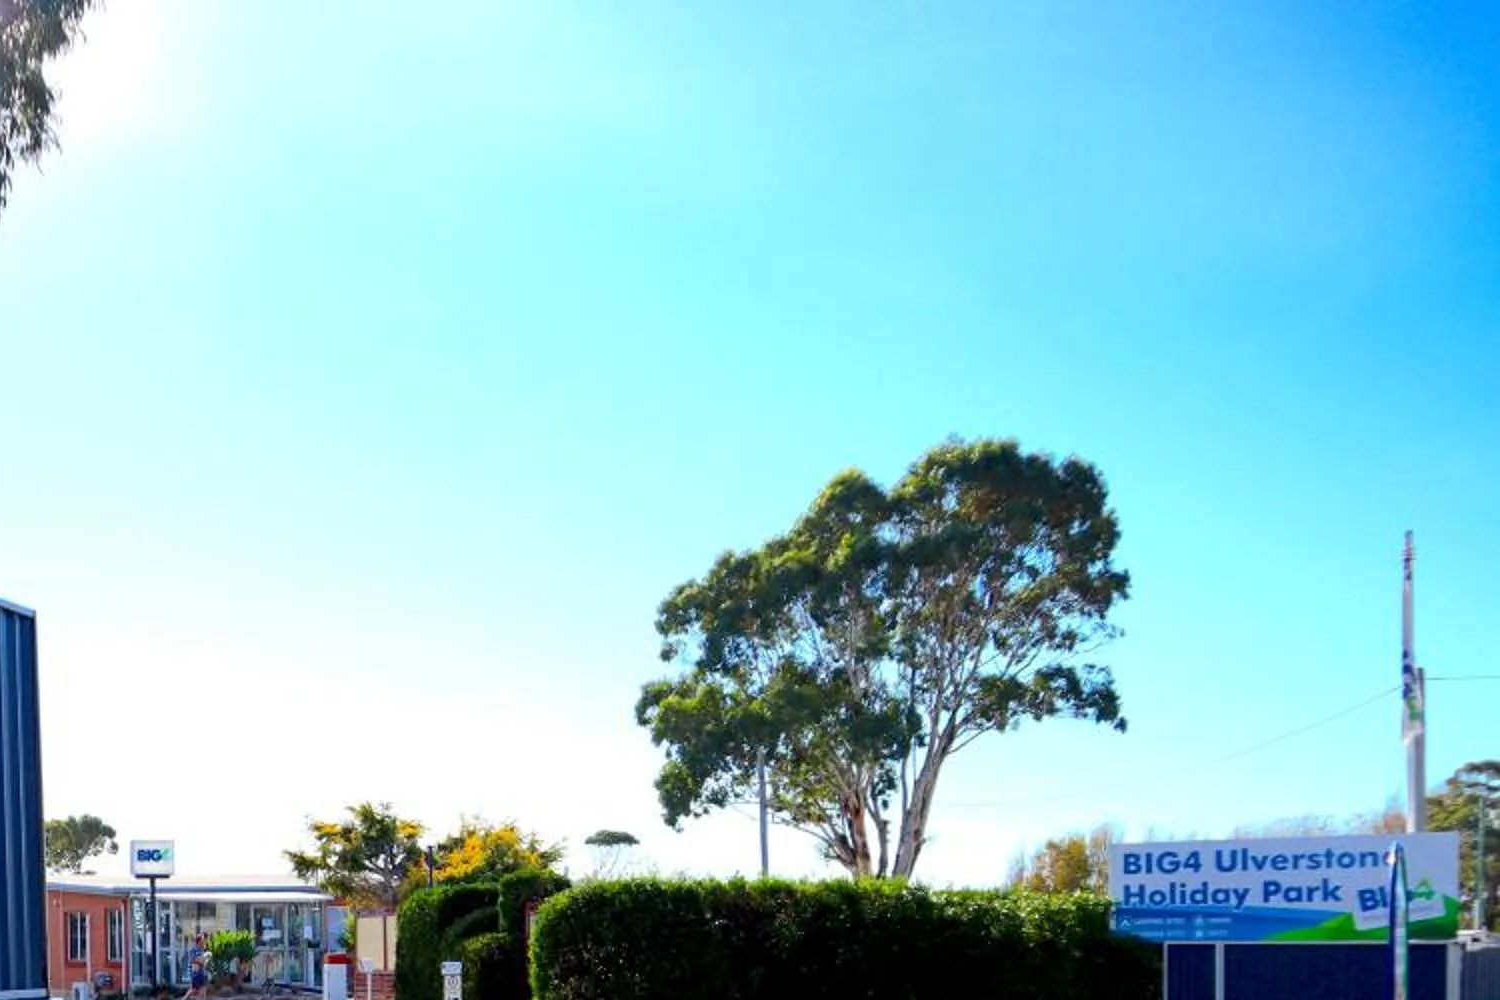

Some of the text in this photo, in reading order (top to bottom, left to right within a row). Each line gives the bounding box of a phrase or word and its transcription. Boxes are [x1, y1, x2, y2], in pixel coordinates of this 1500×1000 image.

[1123, 850, 1202, 875] BIG4
[1123, 877, 1343, 910] Holiday Park
[1357, 878, 1436, 912] BI4
